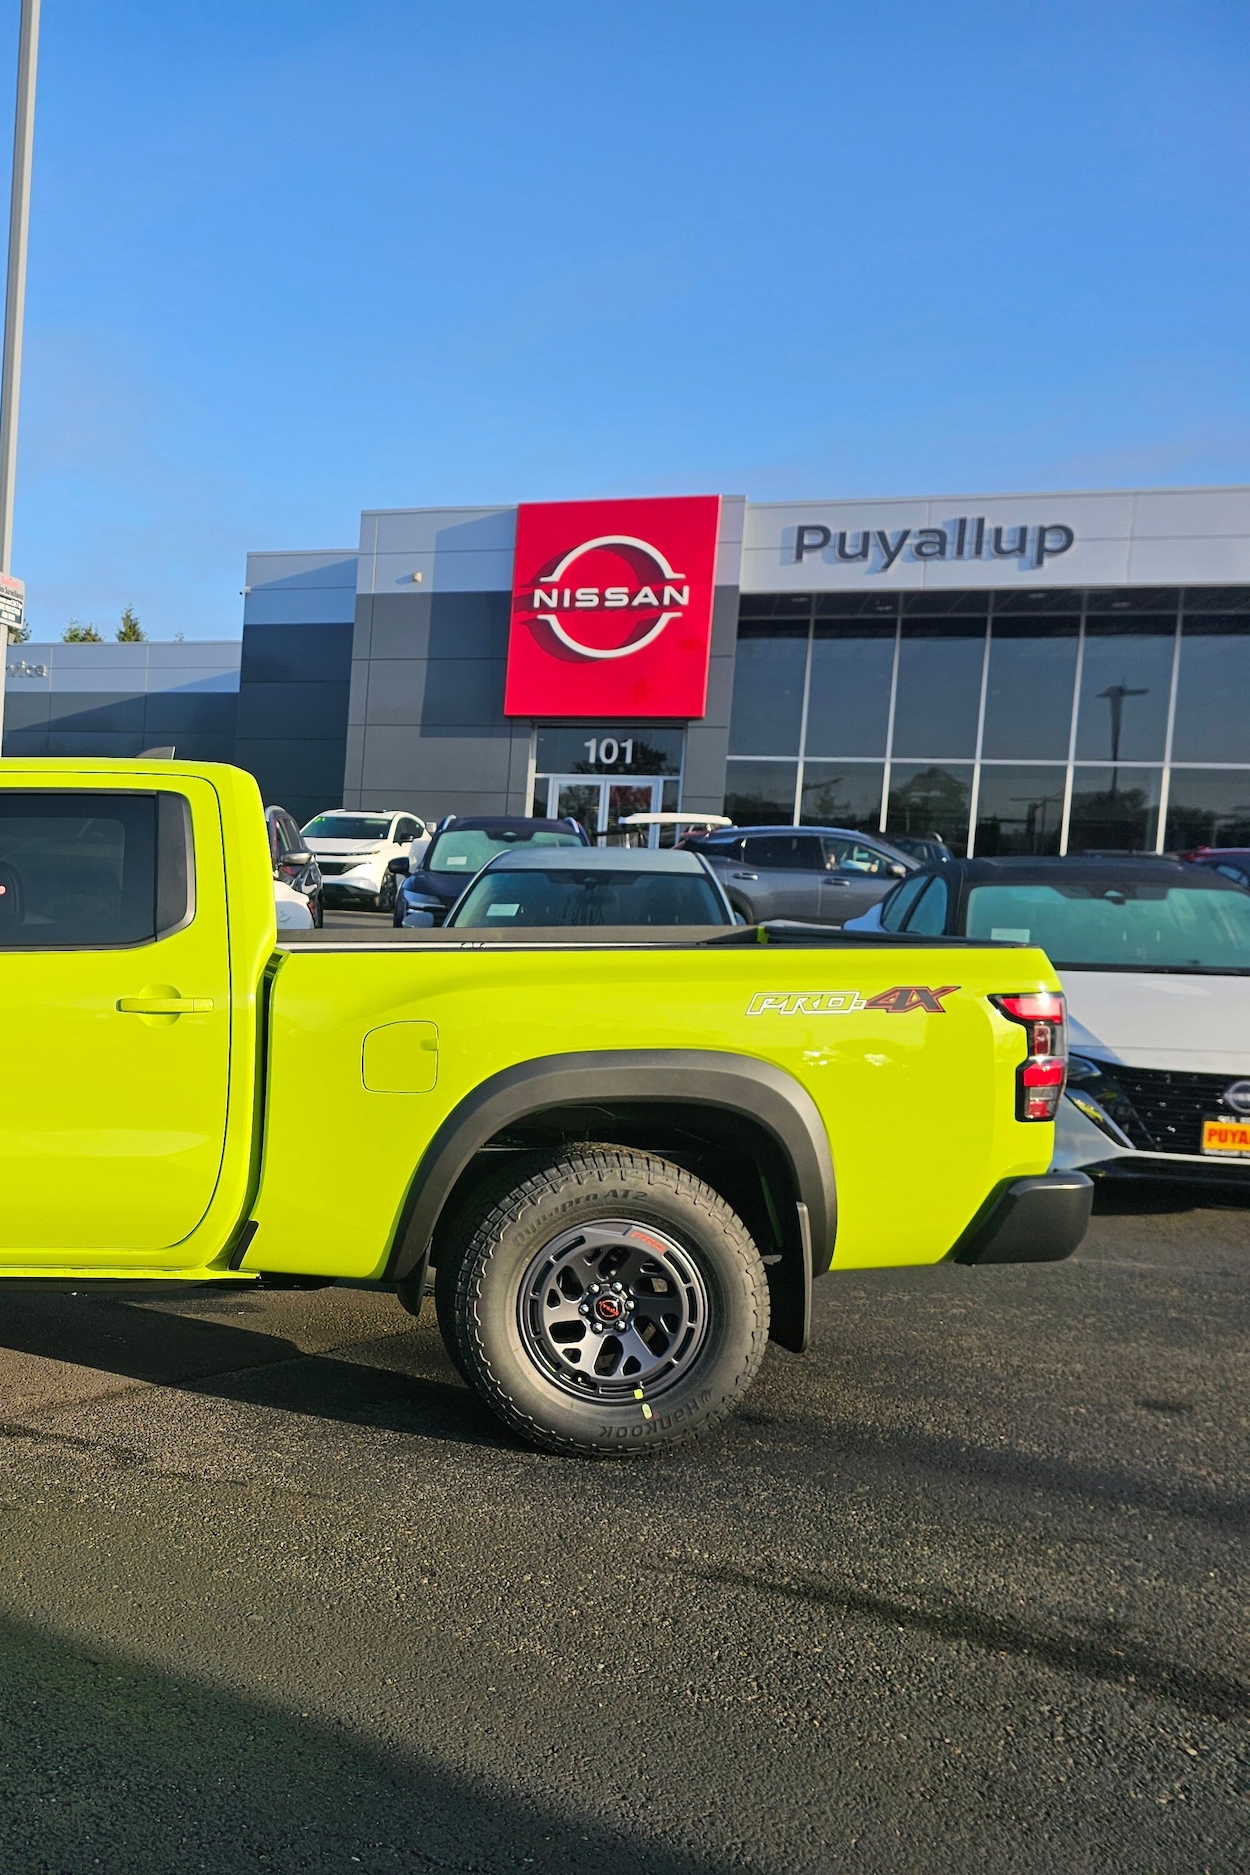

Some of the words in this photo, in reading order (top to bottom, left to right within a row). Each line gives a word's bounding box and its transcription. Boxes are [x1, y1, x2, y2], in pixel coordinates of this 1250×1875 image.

[793, 516, 1075, 571] Puyallup
[533, 585, 690, 609] NISSAN
[583, 737, 634, 765] 101
[745, 986, 962, 1016] PRO-4X
[1207, 1128, 1250, 1145] PUYA
